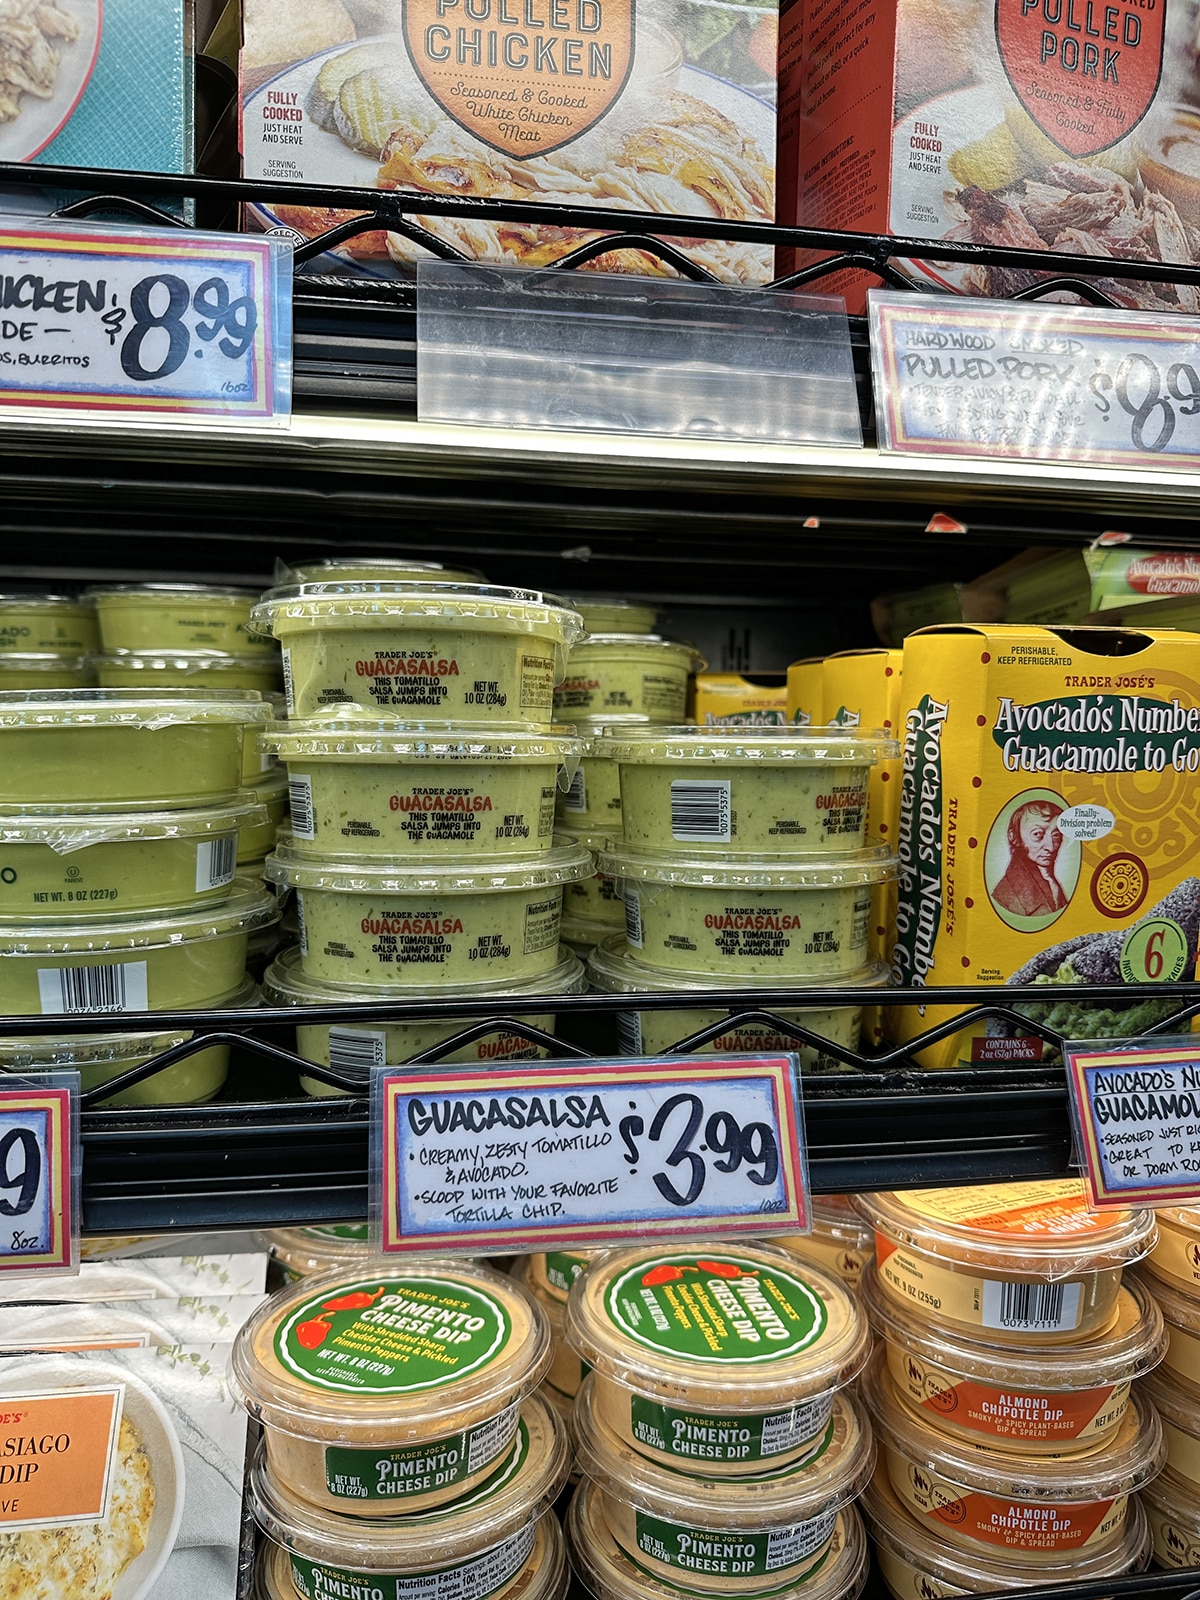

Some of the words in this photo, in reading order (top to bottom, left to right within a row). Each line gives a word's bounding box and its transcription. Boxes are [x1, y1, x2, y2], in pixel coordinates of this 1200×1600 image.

[426, 24, 611, 79] CHICKEN
[1041, 30, 1120, 84] PORK
[268, 91, 298, 105] FULLY
[451, 82, 518, 102] Seasoned
[522, 88, 534, 102] &
[538, 90, 587, 109] Cooked
[1025, 81, 1080, 110] Seasoned
[1084, 96, 1095, 111] &
[1096, 98, 1126, 124] Fully
[263, 107, 302, 122] COOKED
[466, 101, 514, 119] White
[519, 107, 572, 126] Chicken
[263, 123, 281, 134] JUST
[283, 124, 302, 135] HEAT
[498, 123, 541, 142] Meat
[914, 122, 939, 137] FULLY
[1056, 112, 1096, 136] Cooked
[262, 133, 279, 143] AND
[280, 134, 303, 145] SERVE
[910, 136, 942, 152] COOKED
[263, 168, 303, 178] SUGGESTION
[268, 159, 296, 169] SERVING
[905, 331, 996, 350] HARDWOOD
[18, 353, 90, 368] BURRITOS
[901, 353, 996, 380] PULLED
[997, 357, 1081, 386] PORK
[375, 651, 407, 659] TRADER
[1011, 646, 1058, 656] PERISHABLE,
[355, 659, 460, 676] GUACASALSA
[997, 656, 1017, 665] KEEP
[1018, 657, 1072, 666] REFRIGERATED
[369, 686, 395, 695] SALSA
[397, 687, 426, 696] JUMPS
[428, 686, 448, 696] INTO
[374, 677, 393, 686] THIS
[394, 677, 440, 687] TOMATILLO
[474, 682, 487, 693] NET
[488, 682, 499, 693] WT.
[1064, 676, 1111, 687] TRADER
[1115, 675, 1155, 688] JOSÉ'S
[376, 696, 390, 705] THE
[392, 696, 441, 705] GUACAMOLE
[464, 693, 474, 705] 10
[476, 693, 485, 704] OZ
[486, 693, 507, 706] (284g)
[994, 695, 1114, 734] Avocado's
[1119, 696, 1200, 734] Numbe
[1002, 735, 1138, 773] Guacamole
[1143, 740, 1165, 771] to
[1171, 736, 1199, 772] Go
[898, 708, 924, 892] Guacamole
[1060, 818, 1085, 828] Division
[1086, 819, 1112, 829] problem
[1074, 828, 1097, 838] solved!
[33, 892, 49, 903] NET
[51, 892, 65, 902] WT.
[68, 891, 73, 901] 8
[76, 891, 87, 900] OZ
[90, 889, 118, 901] (227g)
[704, 914, 801, 930] GUACASALSA
[895, 901, 916, 934] to
[715, 938, 740, 947] SALSA
[742, 939, 771, 948] JUMPS
[772, 938, 790, 947] INTO
[722, 931, 740, 939] THIS
[742, 931, 784, 939] TOMATILLO
[721, 947, 735, 955] THE
[738, 947, 784, 956] GUACAMOLE
[1144, 928, 1166, 979] 6
[980, 1050, 985, 1058] 2
[994, 1049, 1012, 1059] (57g)
[1013, 1048, 1035, 1058] PACKS
[985, 1040, 1020, 1049] CONTAINS
[1094, 1068, 1175, 1094] AVOCADO'S
[407, 1094, 611, 1136] GUACASALSA
[1104, 1130, 1154, 1146] SEASONED
[1159, 1125, 1185, 1139] JUST
[485, 1141, 528, 1160] ZESTY
[531, 1132, 613, 1155] TOMATILLO
[1109, 1147, 1153, 1164] GREAT
[1168, 1143, 1183, 1157] TO
[456, 1165, 529, 1187] AVOCADO.
[1123, 1164, 1140, 1177] OR
[1144, 1163, 1178, 1178] DORM
[421, 1190, 465, 1206] SCOOP
[472, 1186, 507, 1202] WITH
[512, 1184, 549, 1200] YOUR
[552, 1178, 620, 1198] FAVORITE
[445, 1204, 513, 1224] TORTILLA
[522, 1201, 566, 1218] CHIP.
[397, 1287, 437, 1302] TRADER
[439, 1297, 470, 1309] JOE'S
[374, 1294, 486, 1332] PIMENTO
[707, 1279, 746, 1320] CHEESE
[732, 1320, 761, 1342] DIP
[726, 1277, 790, 1339] PIMENTO
[360, 1309, 431, 1336] CHEESE
[435, 1325, 473, 1345] DIP
[1003, 1318, 1029, 1328] 0073
[1033, 1320, 1058, 1328] 7111
[351, 1321, 375, 1335] With
[374, 1326, 418, 1347] Shredded
[418, 1335, 446, 1352] Sharp
[332, 1336, 372, 1354] Pimento
[372, 1344, 411, 1363] Peppers
[342, 1329, 380, 1346] Cheddar
[380, 1336, 413, 1353] Cheese
[413, 1346, 422, 1356] &
[421, 1348, 459, 1365] Pickled
[981, 1402, 1042, 1421] CHIPOTLE
[1044, 1409, 1064, 1421] DIP
[999, 1394, 1049, 1410] ALMOND
[967, 1410, 992, 1424] SMOKY
[1006, 1418, 1027, 1428] SPICY
[1028, 1420, 1075, 1430] PLANT-BASED
[996, 1425, 1009, 1434] DIP
[1012, 1426, 1018, 1434] &
[1020, 1427, 1047, 1437] SPREAD
[0, 1463, 38, 1484] DIP
[376, 1449, 459, 1482] PIMENTO
[376, 1476, 431, 1496] CHEESE
[435, 1467, 458, 1485] DIP
[990, 1513, 1049, 1531] CHIPOTLE
[1051, 1519, 1071, 1531] DIP
[1008, 1506, 1057, 1521] ALMOND
[399, 1578, 440, 1590] Nutrition
[438, 1570, 461, 1584] Facts
[462, 1563, 486, 1576] Servings:
